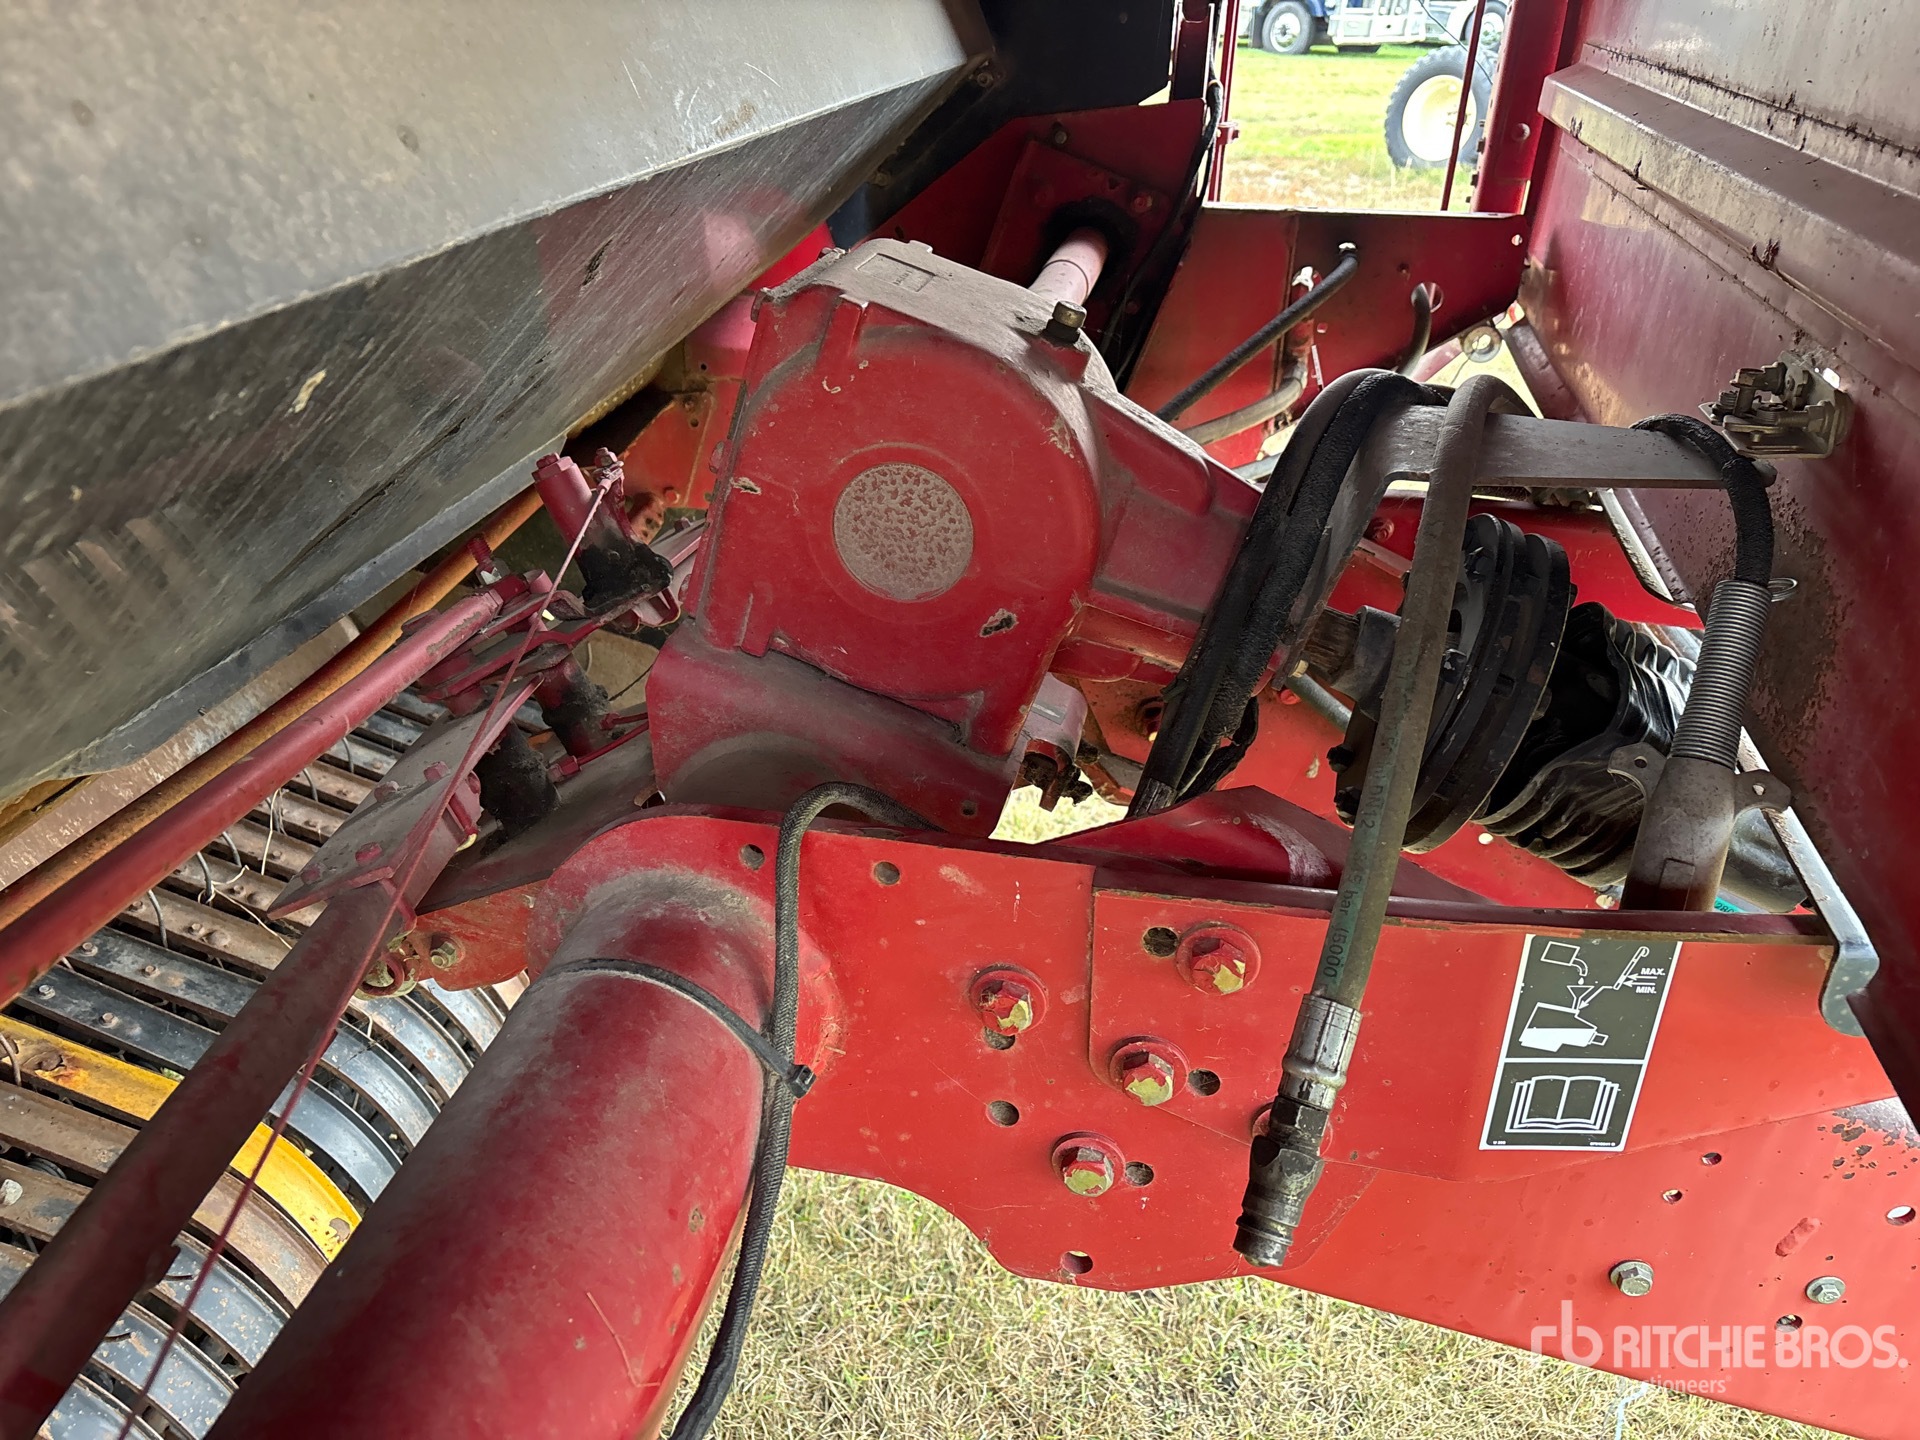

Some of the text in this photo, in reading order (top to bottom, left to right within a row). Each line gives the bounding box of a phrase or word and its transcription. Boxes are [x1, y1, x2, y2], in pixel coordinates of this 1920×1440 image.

[1339, 889, 1358, 917] bar
[1640, 967, 1665, 975] MAX.
[1635, 985, 1656, 994] MIN.
